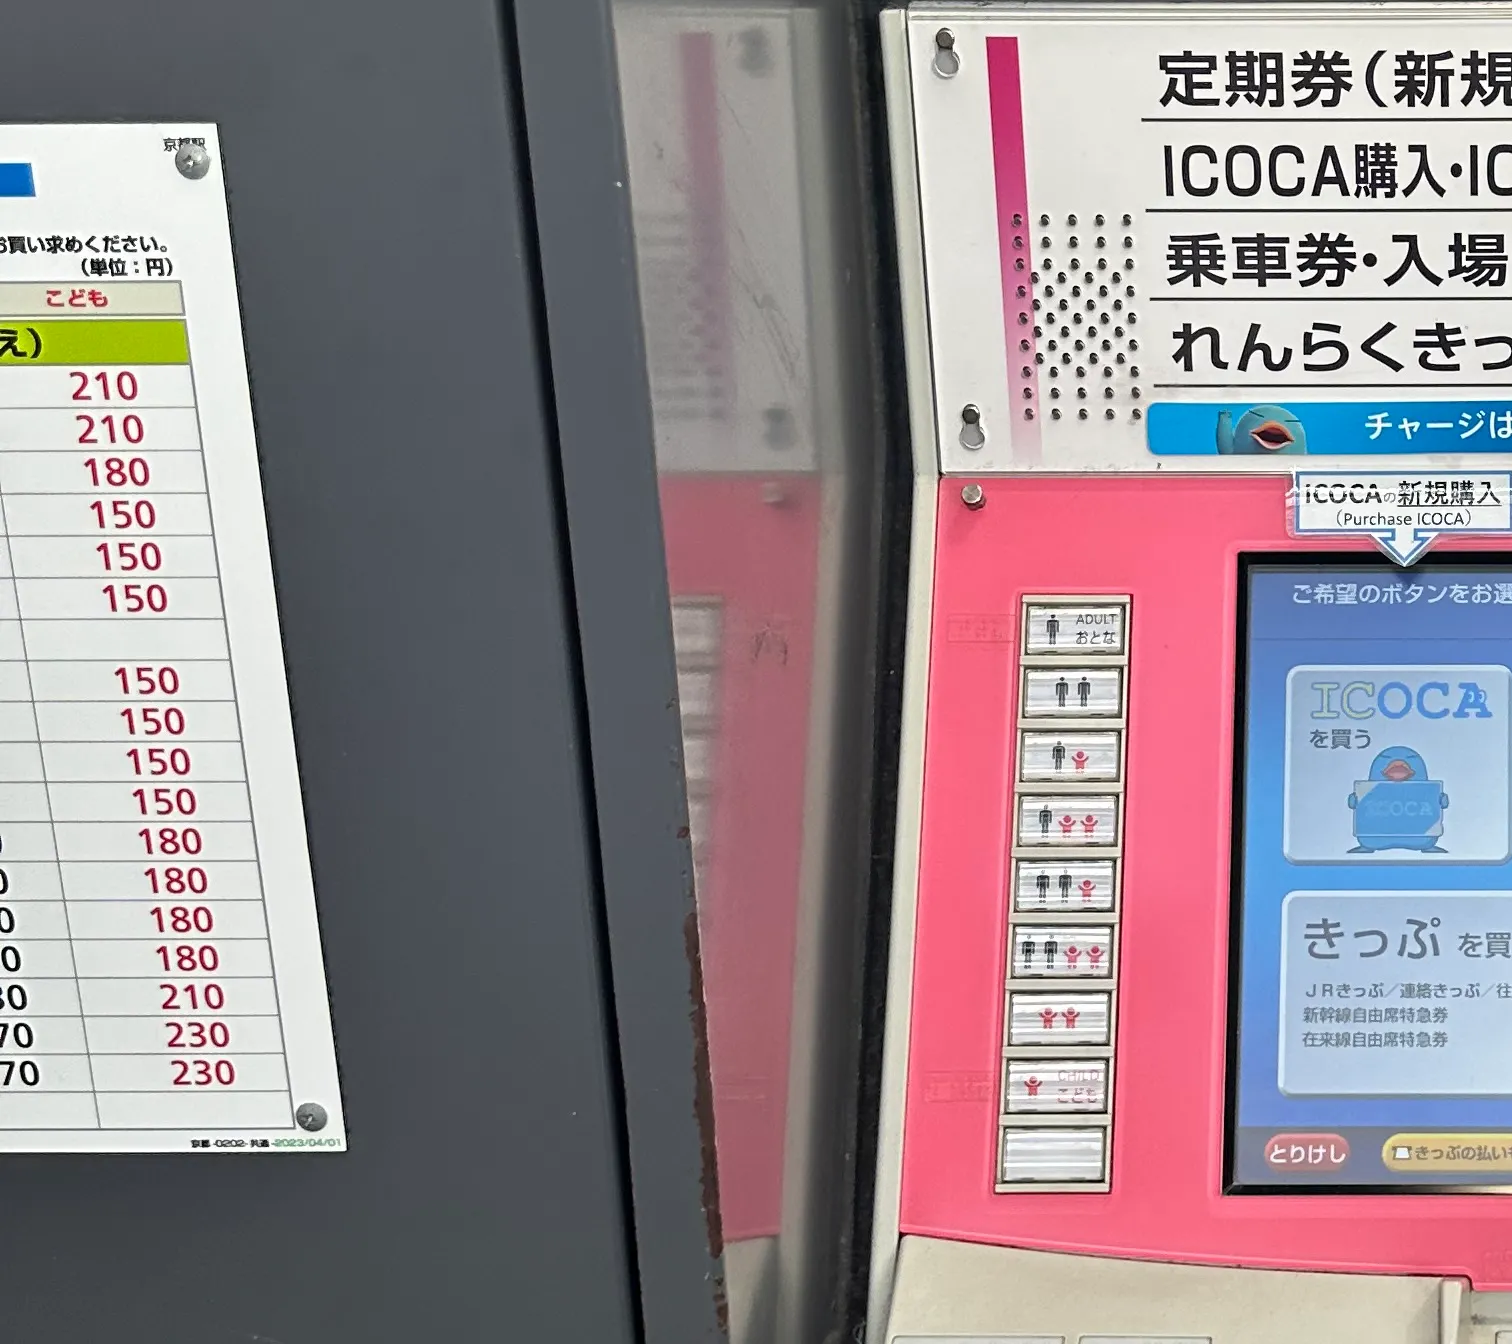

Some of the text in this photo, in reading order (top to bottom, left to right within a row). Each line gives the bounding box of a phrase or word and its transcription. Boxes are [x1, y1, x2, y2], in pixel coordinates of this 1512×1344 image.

[46, 288, 109, 307] こども
[70, 371, 139, 401] 210
[75, 414, 145, 444] 210
[83, 457, 151, 487] 180
[89, 500, 157, 530] 150
[96, 542, 163, 572] 150
[101, 584, 169, 614] 150
[1075, 613, 1118, 625] ADULT
[1075, 629, 1116, 645] おとな
[114, 666, 181, 696] 150
[1310, 681, 1493, 720] ICOCA
[120, 707, 186, 736] 150
[1309, 727, 1372, 750] を買う
[126, 747, 192, 776] 150
[132, 788, 197, 816] 150
[138, 827, 203, 856] 180
[144, 866, 209, 895] 180
[150, 906, 214, 934] 180
[1303, 917, 1441, 960] きっぷ
[155, 945, 220, 972] 180
[161, 983, 225, 1010] 210
[166, 1022, 231, 1049] 230
[0, 1060, 237, 1086] 70 230
[1269, 1142, 1347, 1164] とりけし
